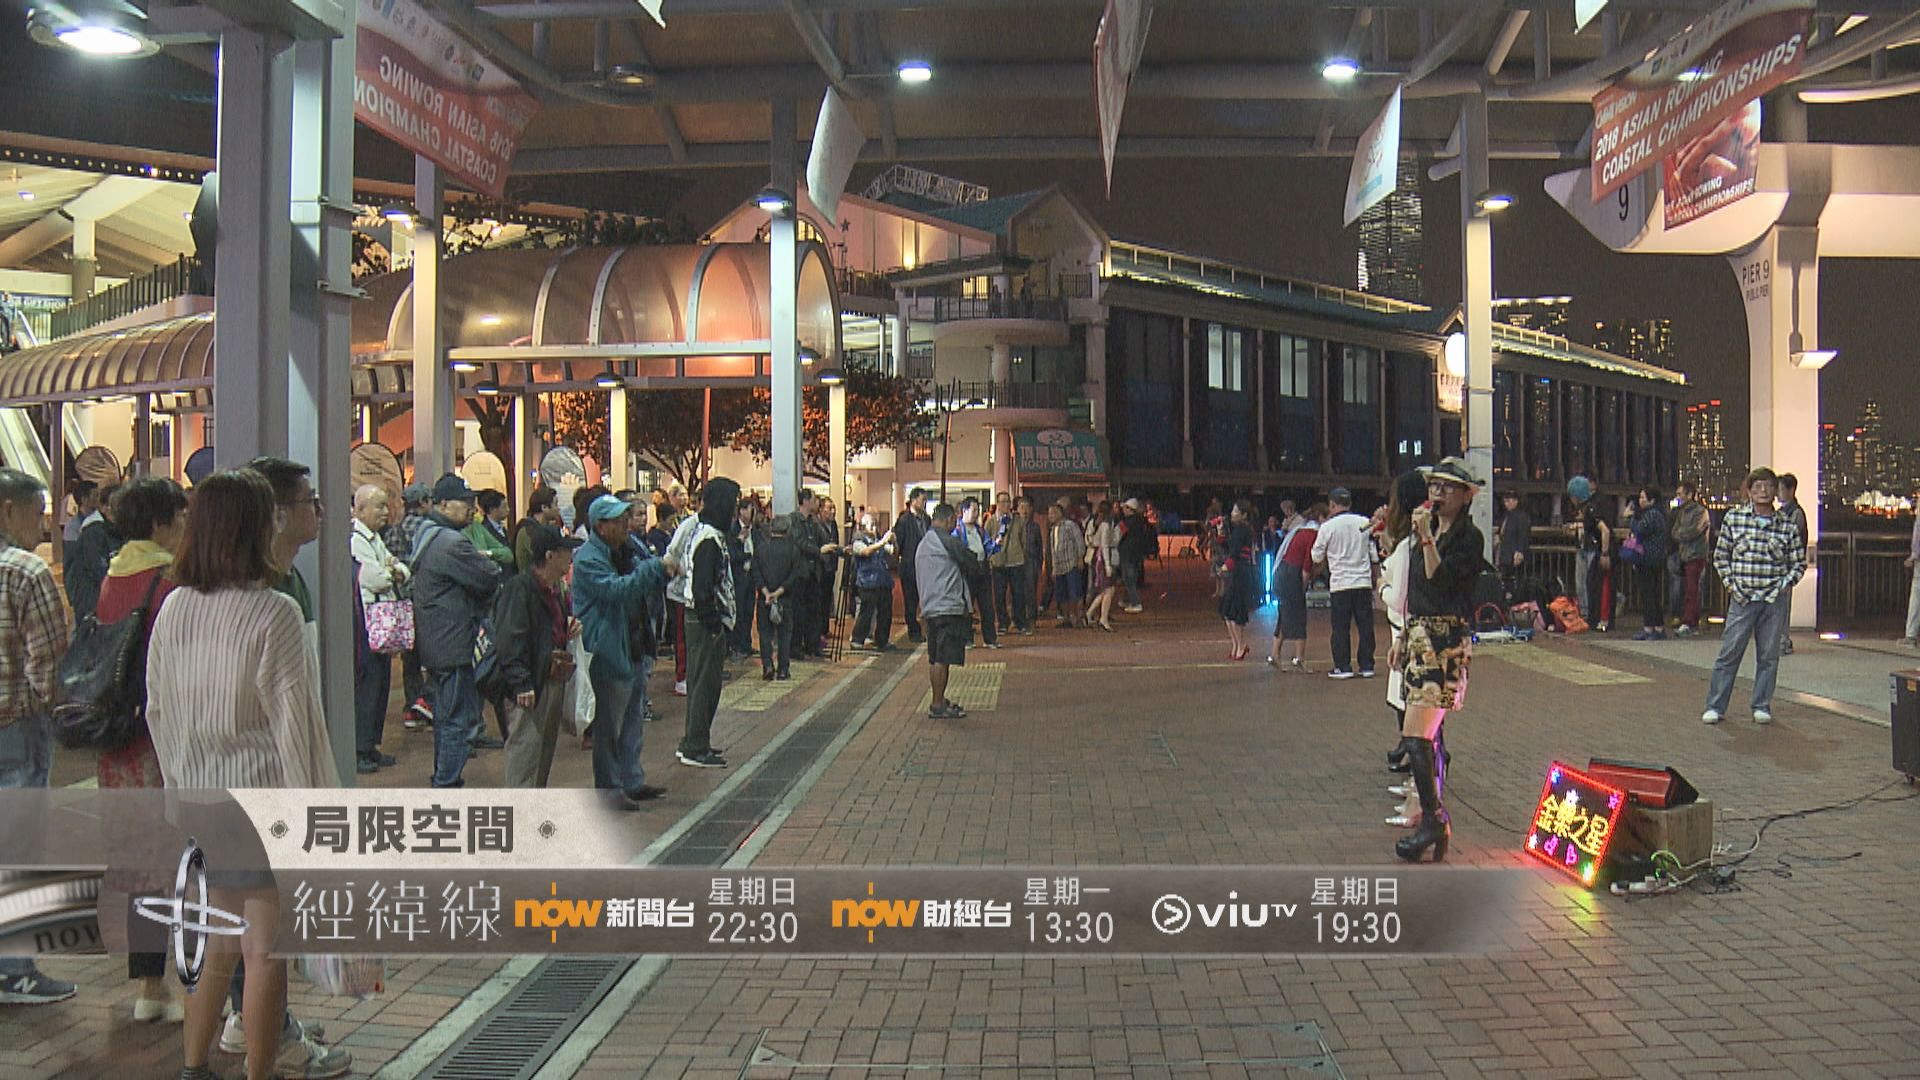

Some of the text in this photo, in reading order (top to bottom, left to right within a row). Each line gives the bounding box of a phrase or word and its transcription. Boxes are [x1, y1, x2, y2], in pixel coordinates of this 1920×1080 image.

[1595, 127, 1619, 161] 2018
[1621, 99, 1662, 144] ASIAN
[1664, 49, 1724, 115] ROWING
[1602, 134, 1652, 185] COASTAL
[1658, 34, 1801, 148] CHAMPIONSHIPS
[1618, 183, 1629, 221] 9
[1743, 259, 1769, 287] PIER 9
[1021, 460, 1070, 470] ROOFTOP
